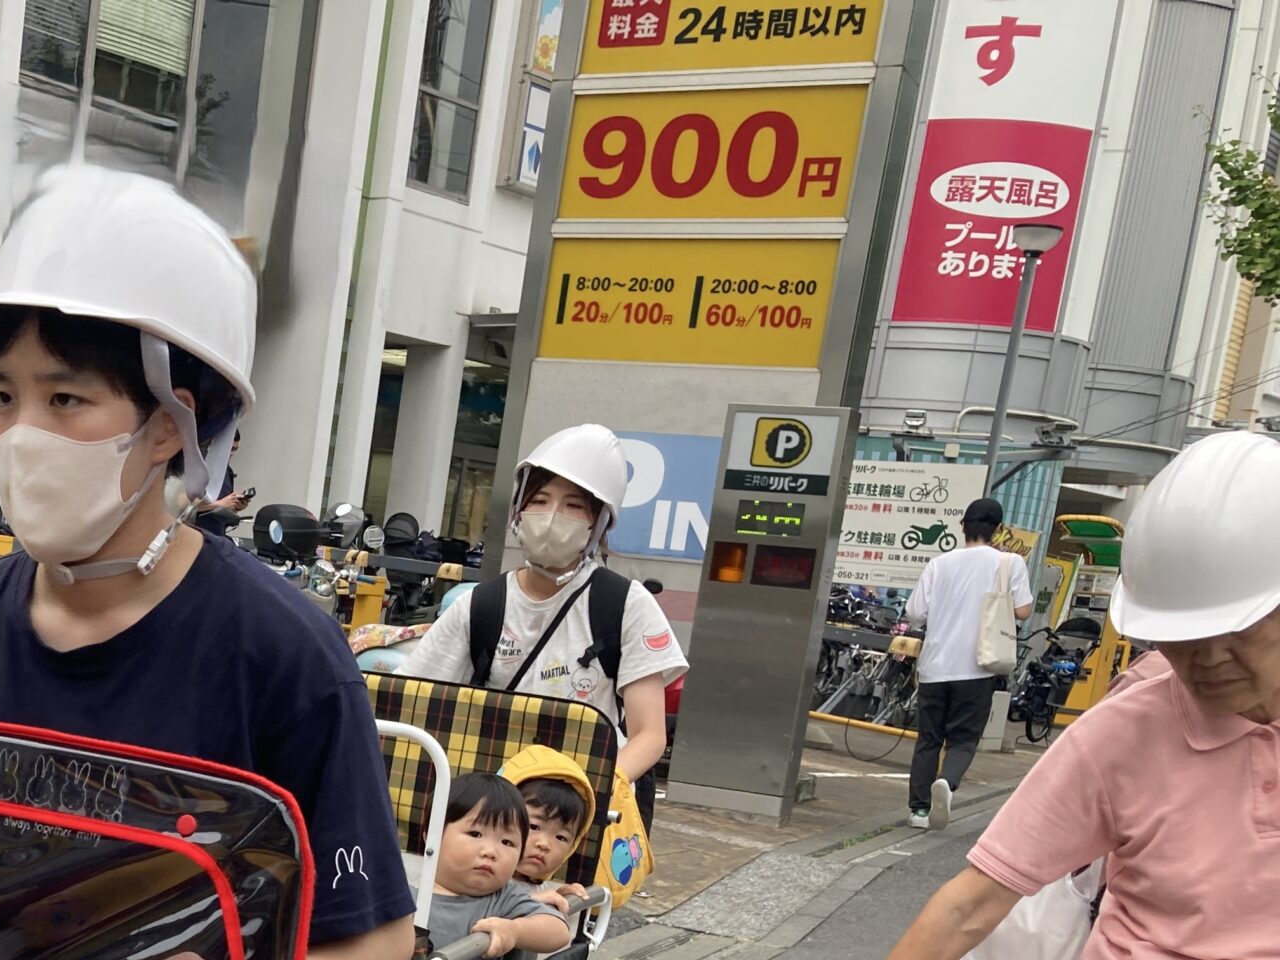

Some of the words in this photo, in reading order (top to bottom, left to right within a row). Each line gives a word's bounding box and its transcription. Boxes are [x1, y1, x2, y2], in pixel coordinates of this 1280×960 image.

[608, 12, 659, 40] 料金
[674, 5, 867, 44] 24時間以内
[965, 16, 1042, 86] す
[579, 111, 842, 199] 900円
[945, 175, 1059, 209] 露天風呂
[945, 221, 1018, 250] プール
[775, 430, 800, 458] P
[540, 665, 570, 681] MARTIAL
